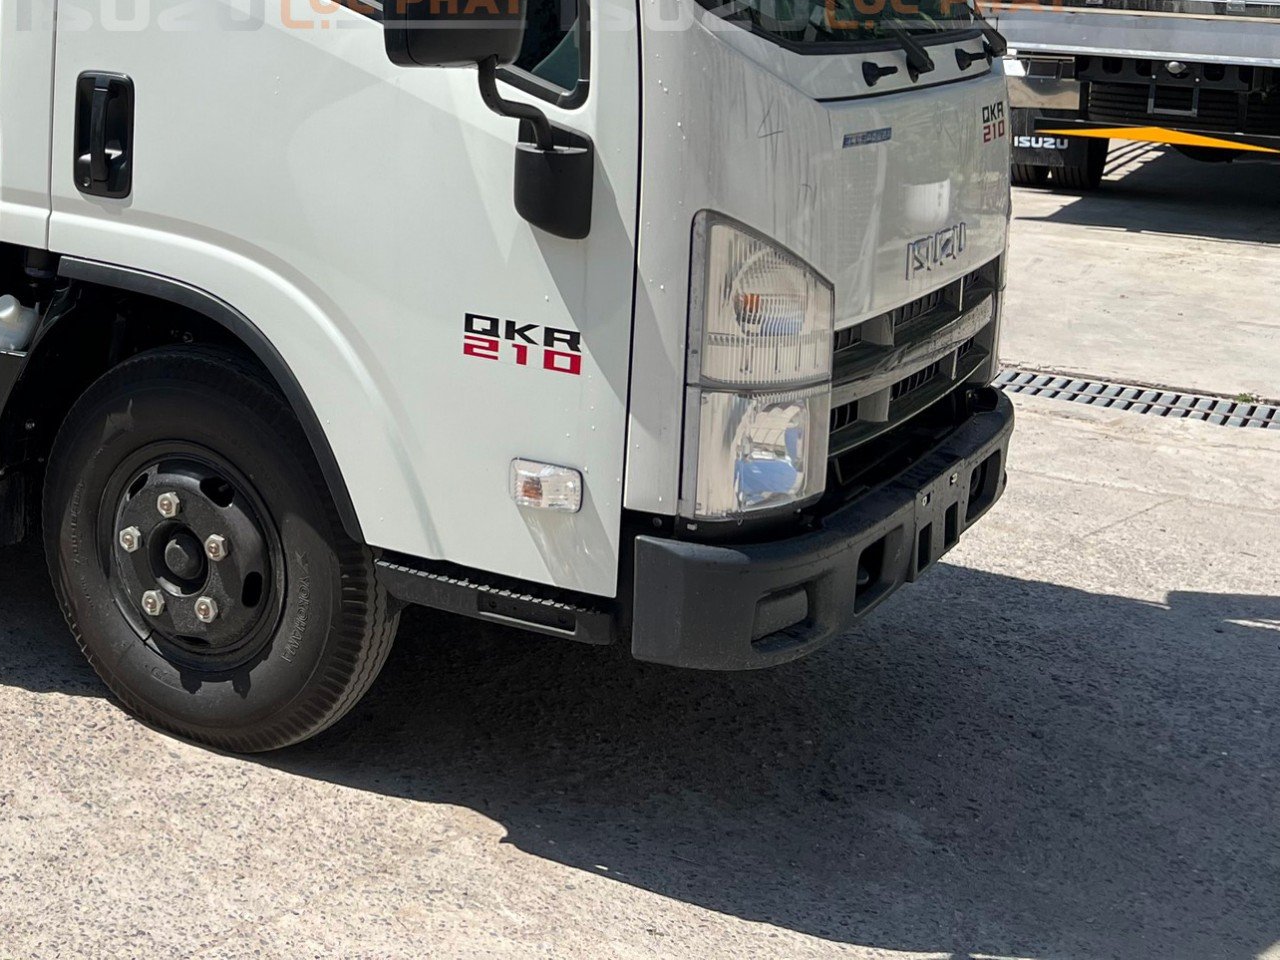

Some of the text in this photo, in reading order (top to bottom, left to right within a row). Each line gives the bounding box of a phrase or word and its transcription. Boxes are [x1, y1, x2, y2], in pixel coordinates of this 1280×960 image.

[982, 101, 1004, 124] QKR
[983, 122, 1004, 143] 210
[1014, 135, 1069, 150] ISUZU
[464, 313, 582, 353] QKR
[463, 335, 582, 376] 210
